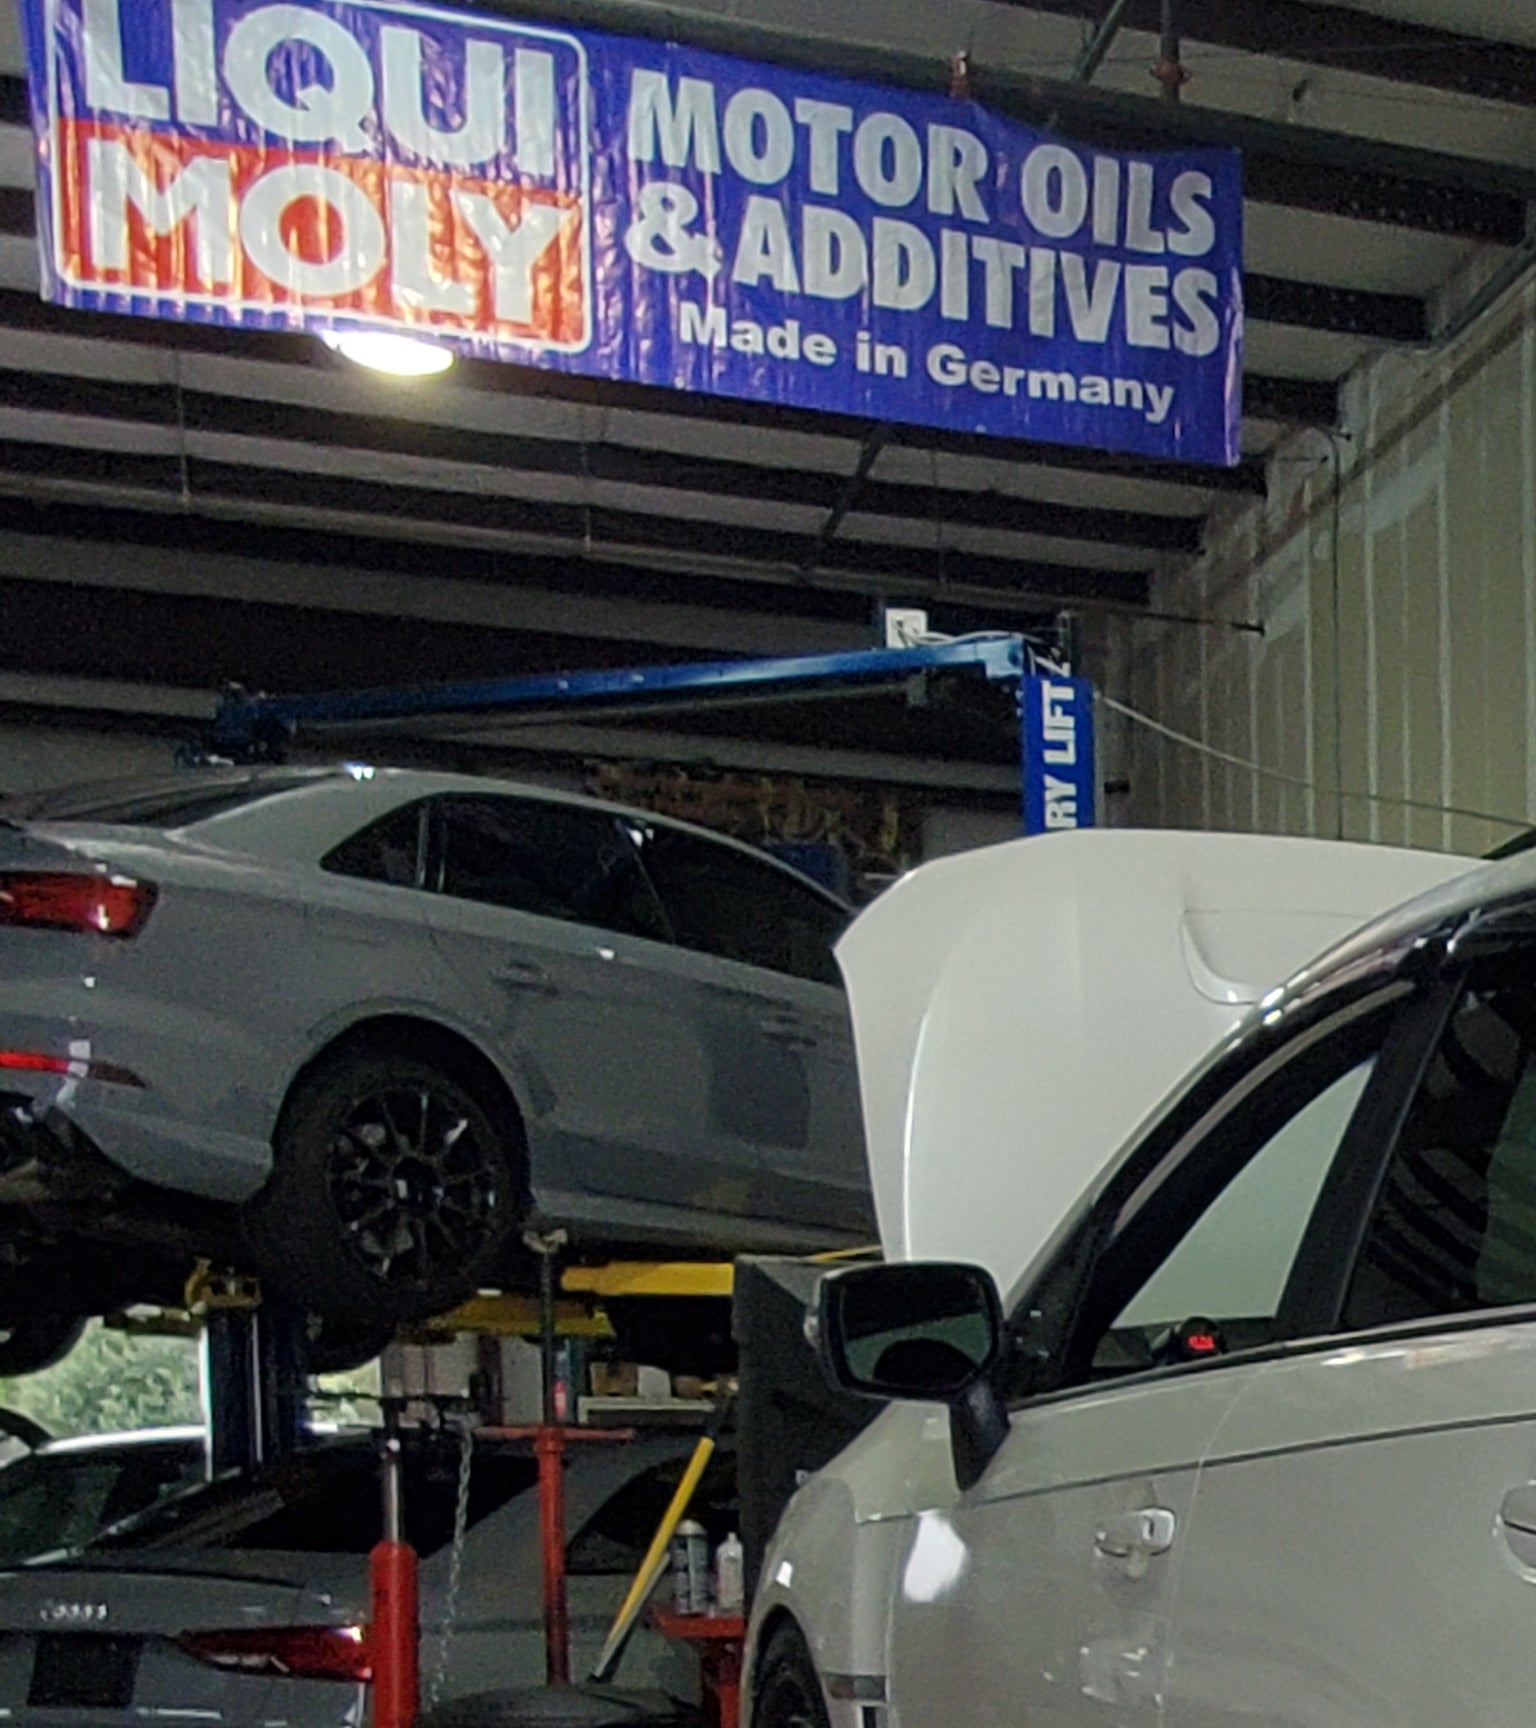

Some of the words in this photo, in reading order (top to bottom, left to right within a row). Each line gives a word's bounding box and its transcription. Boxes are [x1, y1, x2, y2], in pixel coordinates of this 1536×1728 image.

[82, 0, 555, 177] LIQUI
[626, 68, 990, 225] MOTOR
[1021, 143, 1217, 258] OILS
[87, 137, 575, 325] MOLY
[732, 195, 1221, 358] ADDITIVES
[679, 301, 838, 366] Made
[856, 329, 908, 379] in
[926, 343, 1175, 425] Germany
[1040, 679, 1076, 766] LIFT
